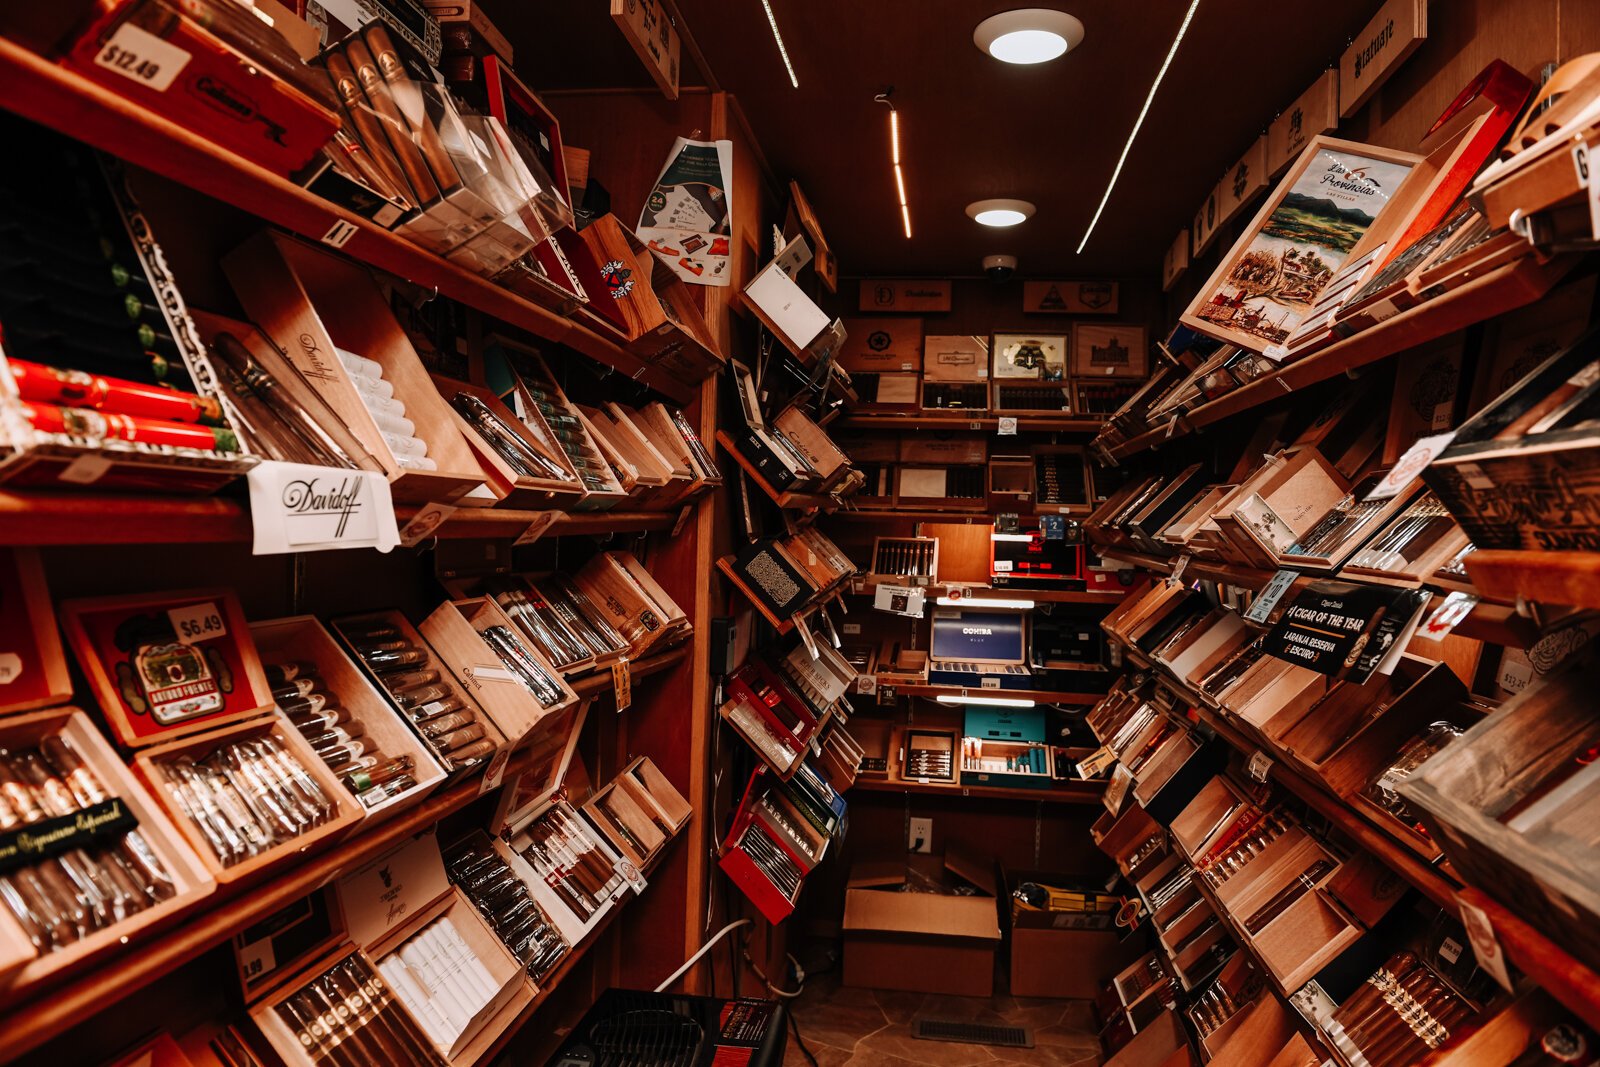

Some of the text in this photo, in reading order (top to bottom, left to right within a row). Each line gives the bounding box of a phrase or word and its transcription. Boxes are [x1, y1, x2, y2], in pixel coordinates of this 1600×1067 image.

[102, 44, 161, 81] $12.49
[1327, 163, 1346, 175] Las
[1320, 173, 1376, 196] Provincias
[327, 225, 358, 247] A1
[299, 332, 340, 386] Davidoff
[282, 476, 362, 538] Davidoff
[180, 615, 222, 637] $6.49
[962, 627, 993, 635] COHIBA
[1294, 607, 1317, 622] CIGAR
[1315, 611, 1329, 623] OF
[1327, 613, 1345, 628] THE
[1343, 617, 1365, 632] YEAR
[1283, 630, 1336, 653] LARANJA RESERVA
[1289, 645, 1315, 660] ESCURO
[183, 680, 215, 697] FUENTE
[463, 667, 482, 690] Cabinet
